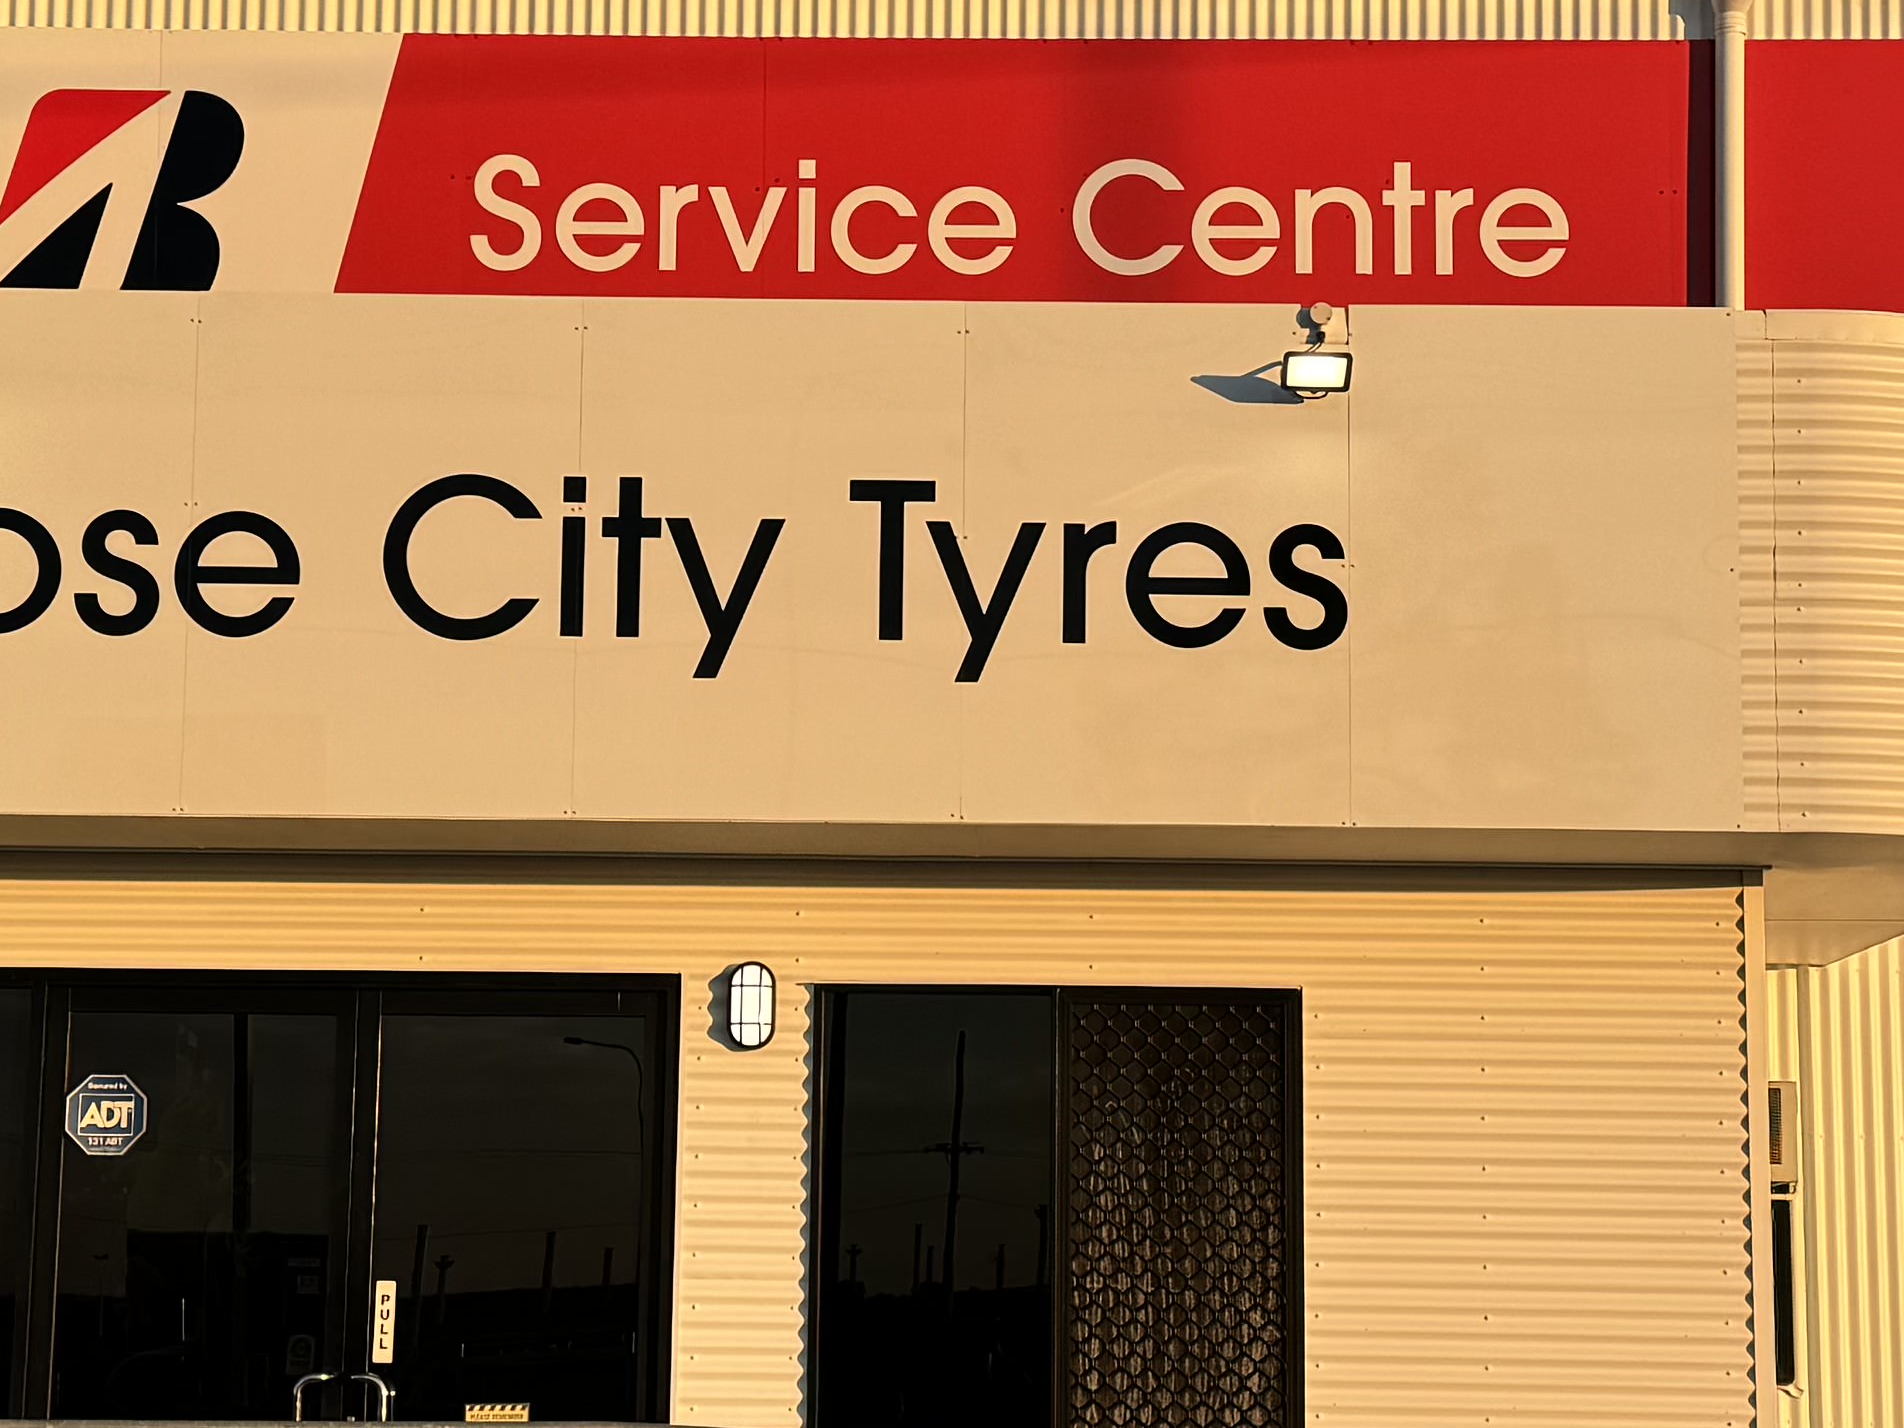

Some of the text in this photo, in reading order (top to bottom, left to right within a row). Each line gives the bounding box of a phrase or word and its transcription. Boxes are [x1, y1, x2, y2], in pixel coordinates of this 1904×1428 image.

[470, 154, 1570, 278] Service Centre
[382, 473, 786, 679] City
[849, 479, 1348, 683] Tyres
[80, 1100, 133, 1128] ADT
[379, 1294, 391, 1350] PULL
